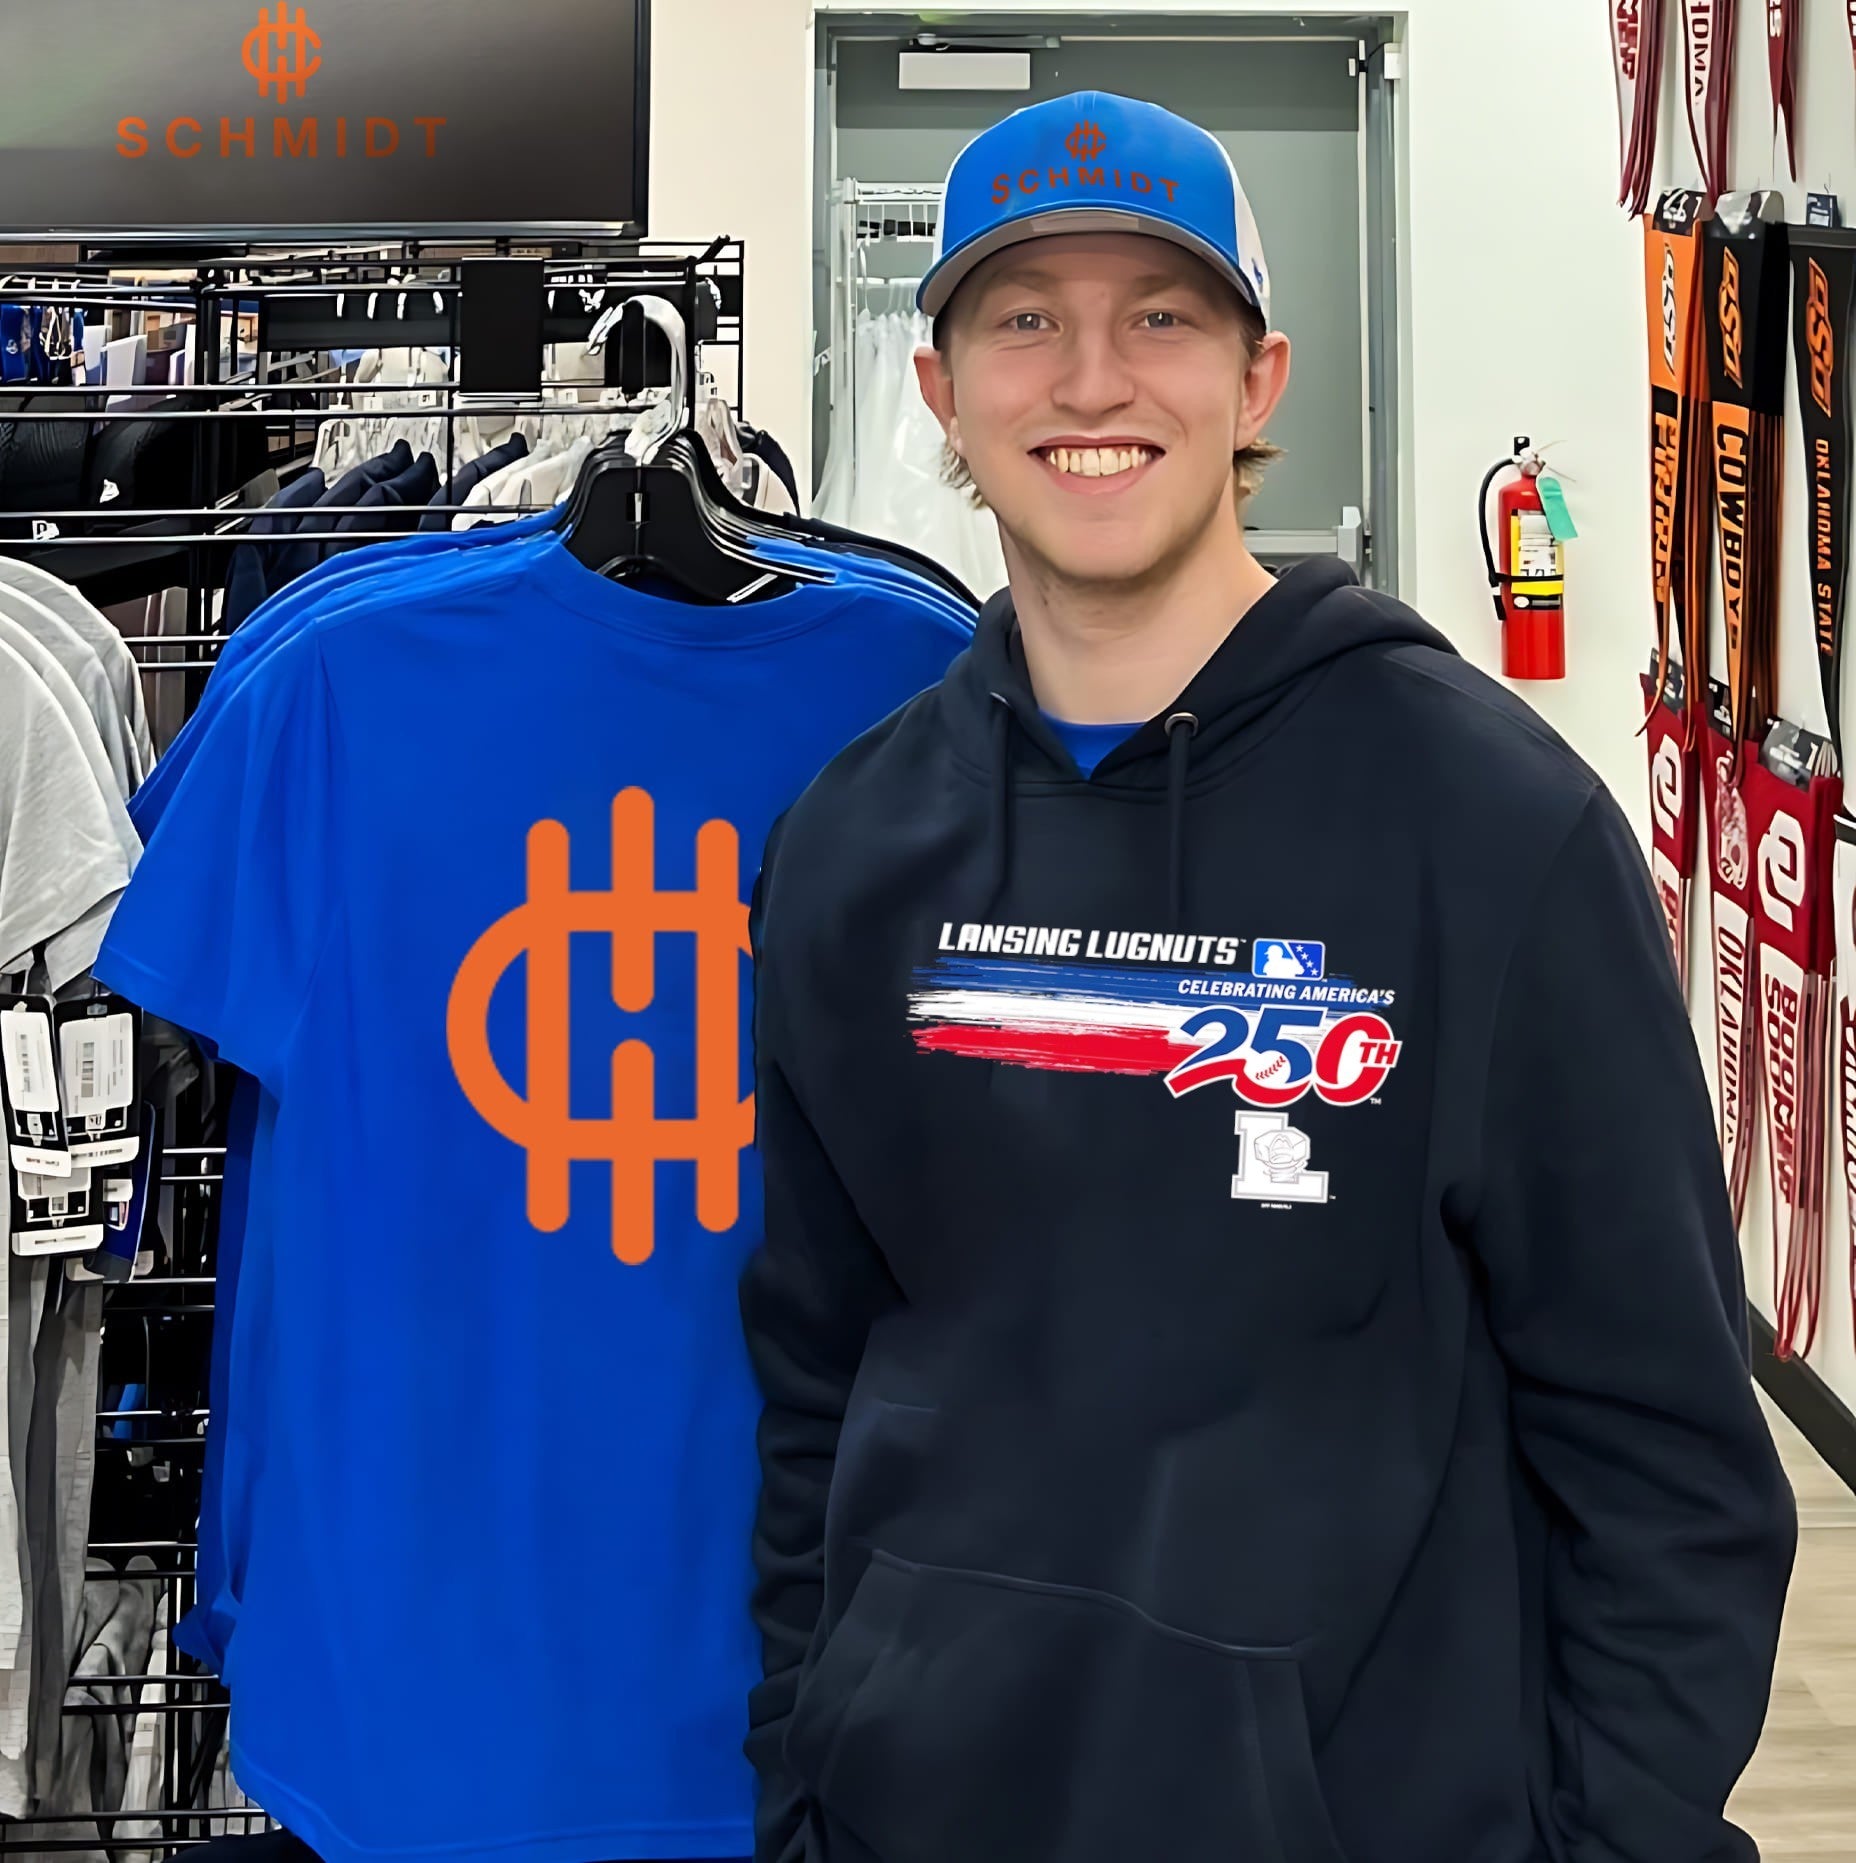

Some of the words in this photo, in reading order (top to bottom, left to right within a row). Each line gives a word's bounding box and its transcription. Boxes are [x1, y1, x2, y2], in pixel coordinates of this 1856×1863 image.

[115, 116, 447, 159] SCHMIDT
[990, 166, 1179, 205] SCHMIDT
[1815, 438, 1832, 570] OKLAHOMA
[938, 922, 1082, 957] LANSING
[1085, 930, 1240, 965] LUGNUTS
[1177, 979, 1296, 1000] CELEBRATING
[1299, 985, 1396, 1006] AMERICA'S
